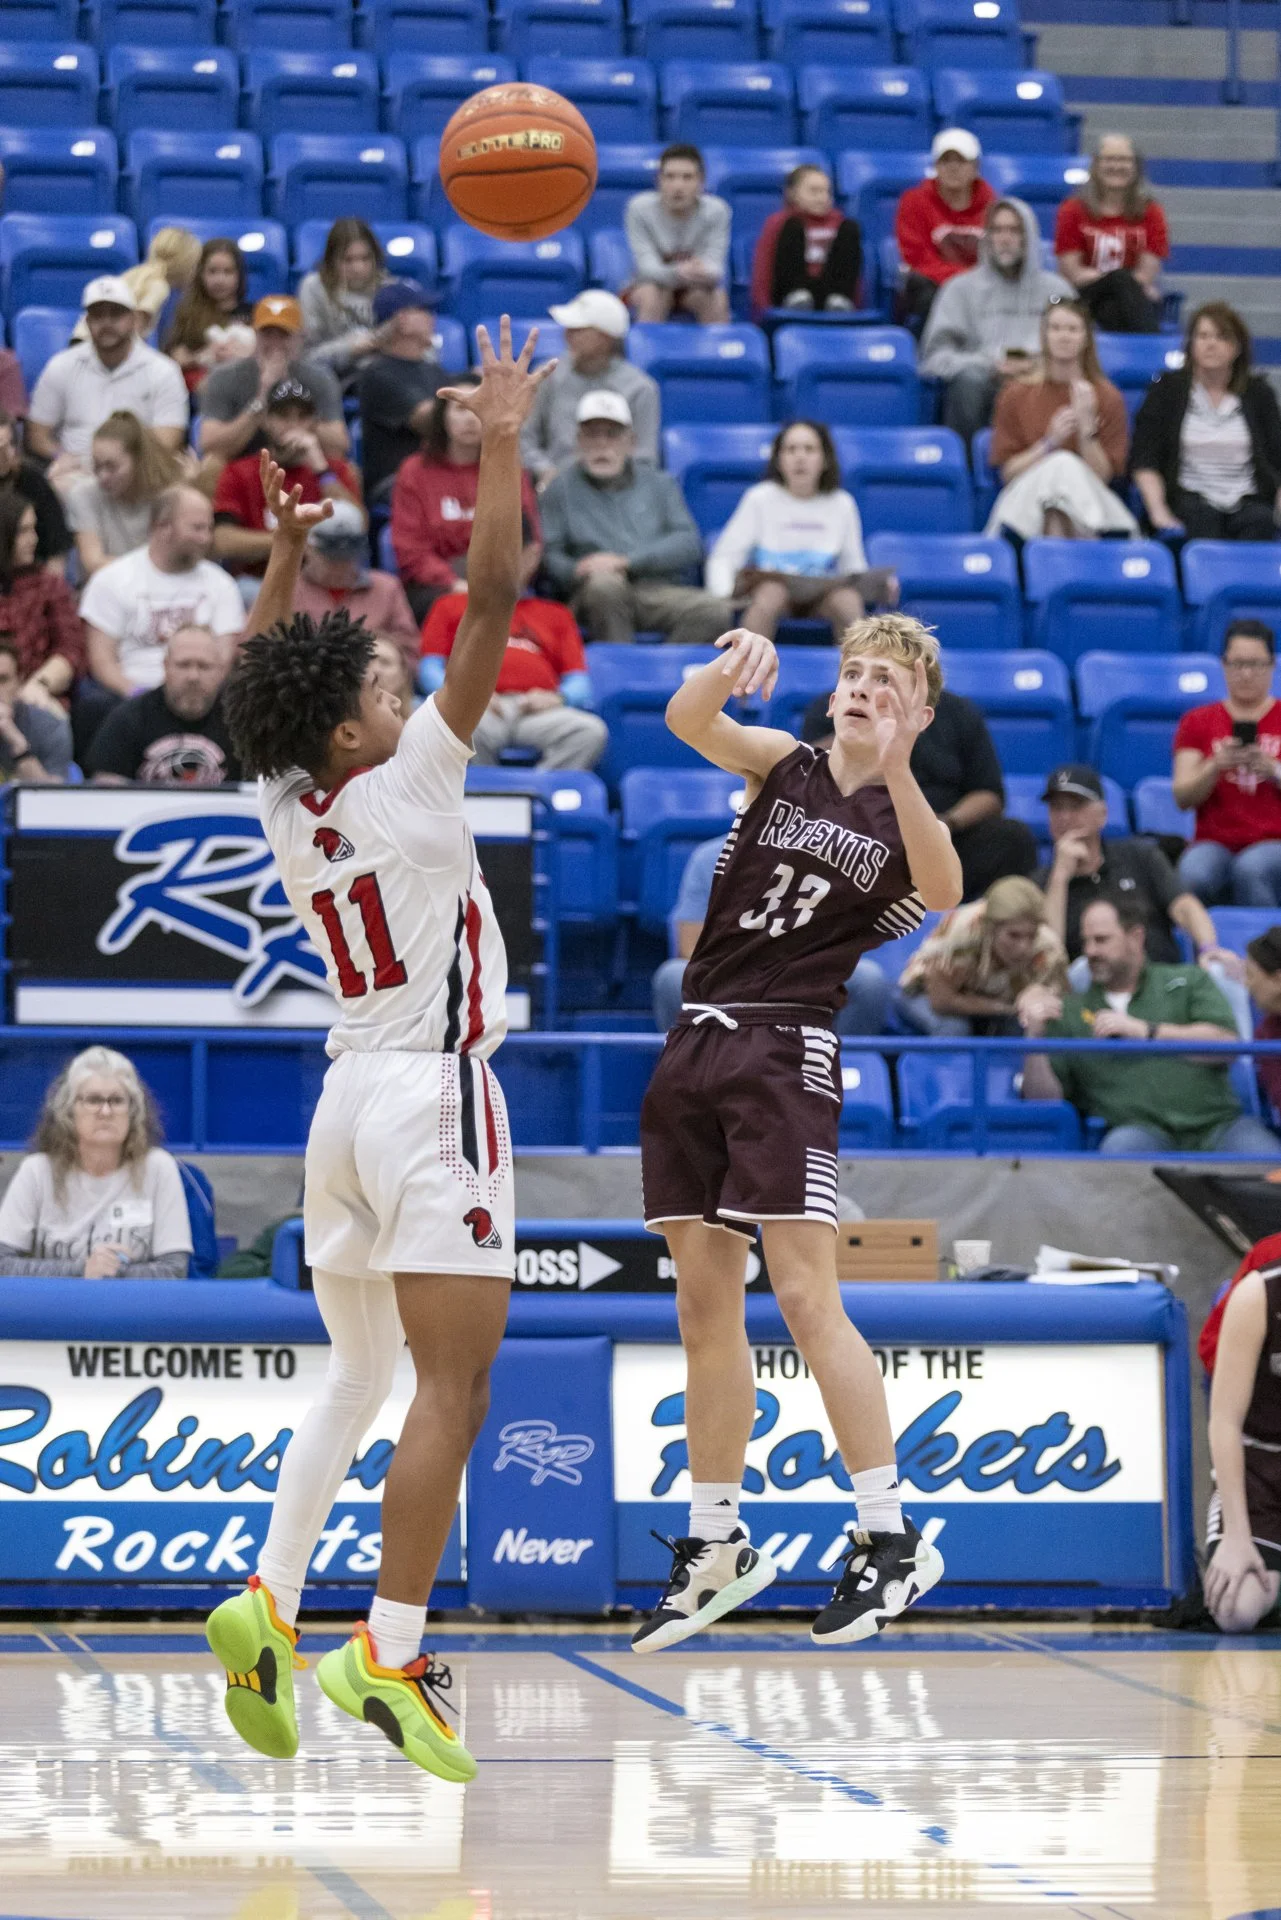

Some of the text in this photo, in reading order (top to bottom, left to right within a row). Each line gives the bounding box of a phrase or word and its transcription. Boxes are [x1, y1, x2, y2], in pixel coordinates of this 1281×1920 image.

[526, 130, 563, 154] PRO
[738, 863, 831, 938] 33
[311, 871, 408, 999] 11
[505, 1249, 579, 1285] OSS
[67, 1346, 296, 1379] WELCOME TO
[755, 1349, 809, 1379] HO
[920, 1350, 983, 1379] THE
[0, 1385, 397, 1493] obinsn
[55, 1515, 382, 1573] Rockts
[492, 1526, 595, 1565] Never
